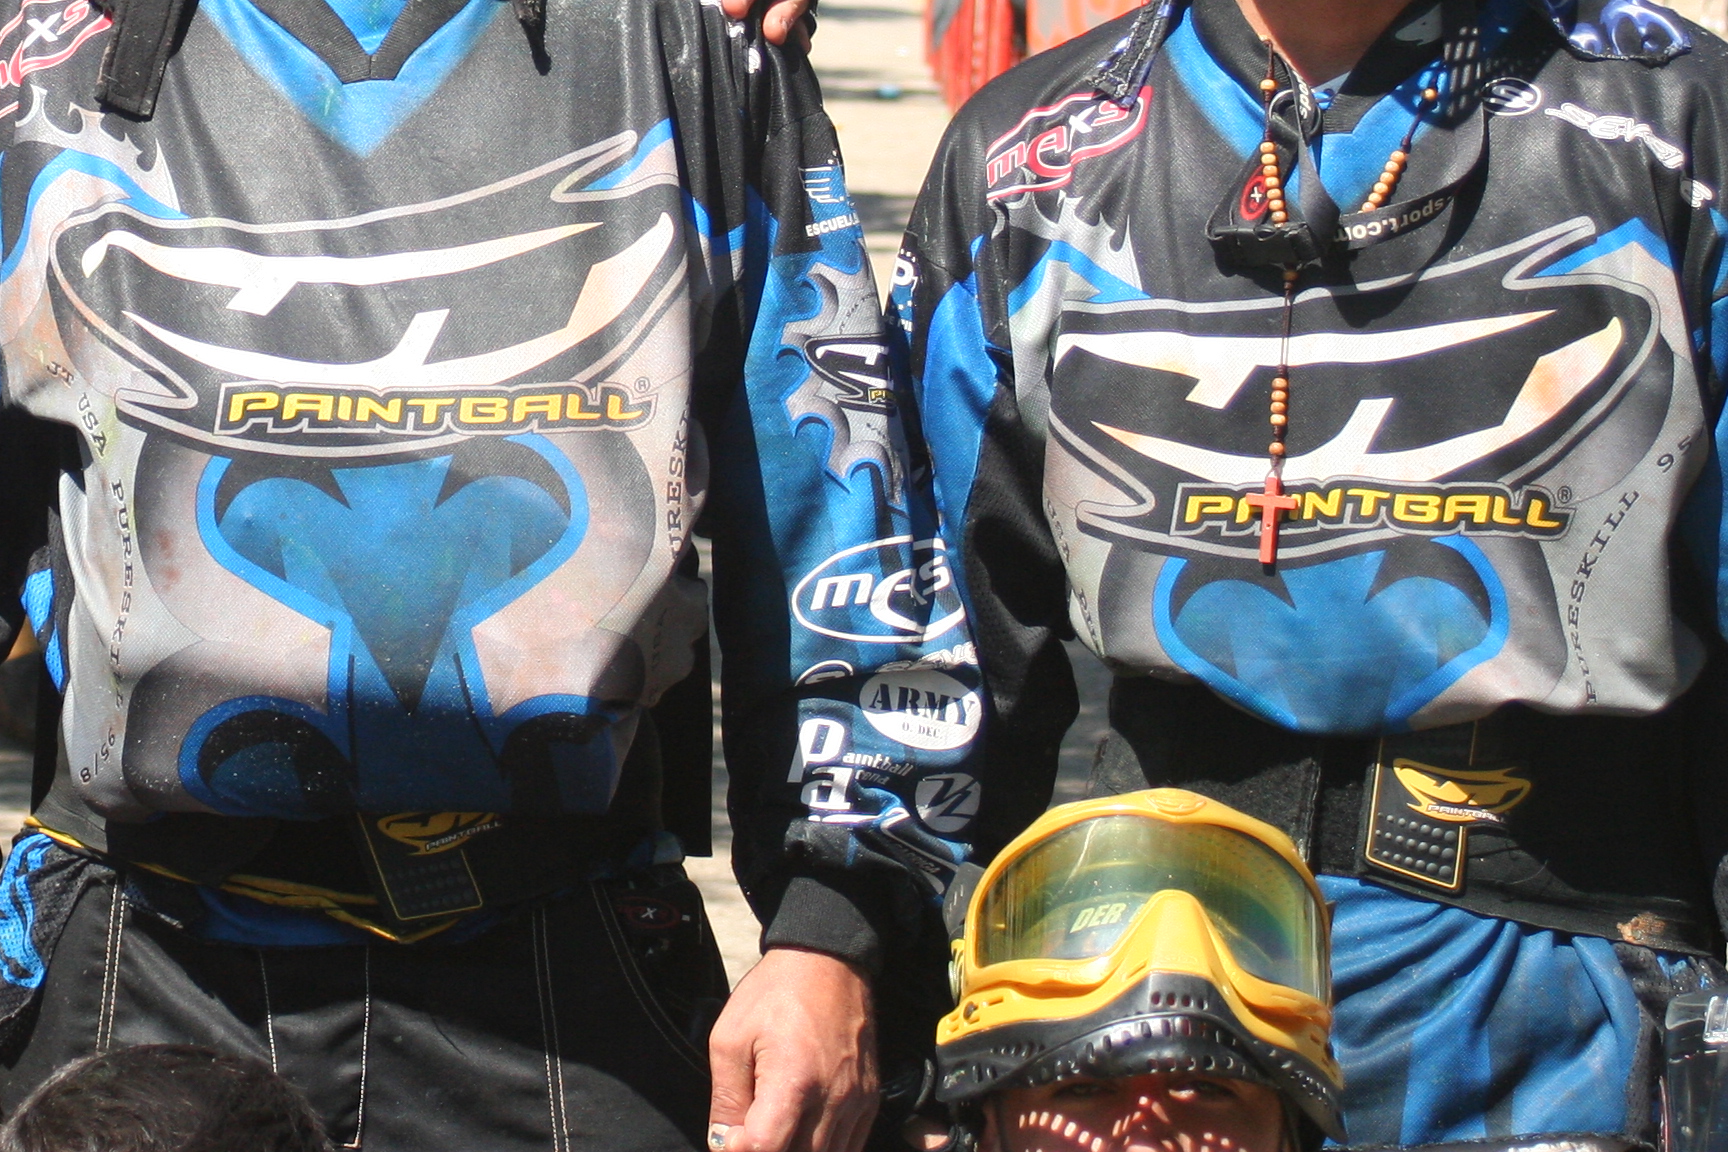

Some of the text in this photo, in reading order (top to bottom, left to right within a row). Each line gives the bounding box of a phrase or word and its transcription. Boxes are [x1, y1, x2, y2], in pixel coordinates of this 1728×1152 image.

[78, 391, 107, 458] USA
[228, 392, 643, 425] PAINTBALL
[869, 683, 975, 726] ARMY
